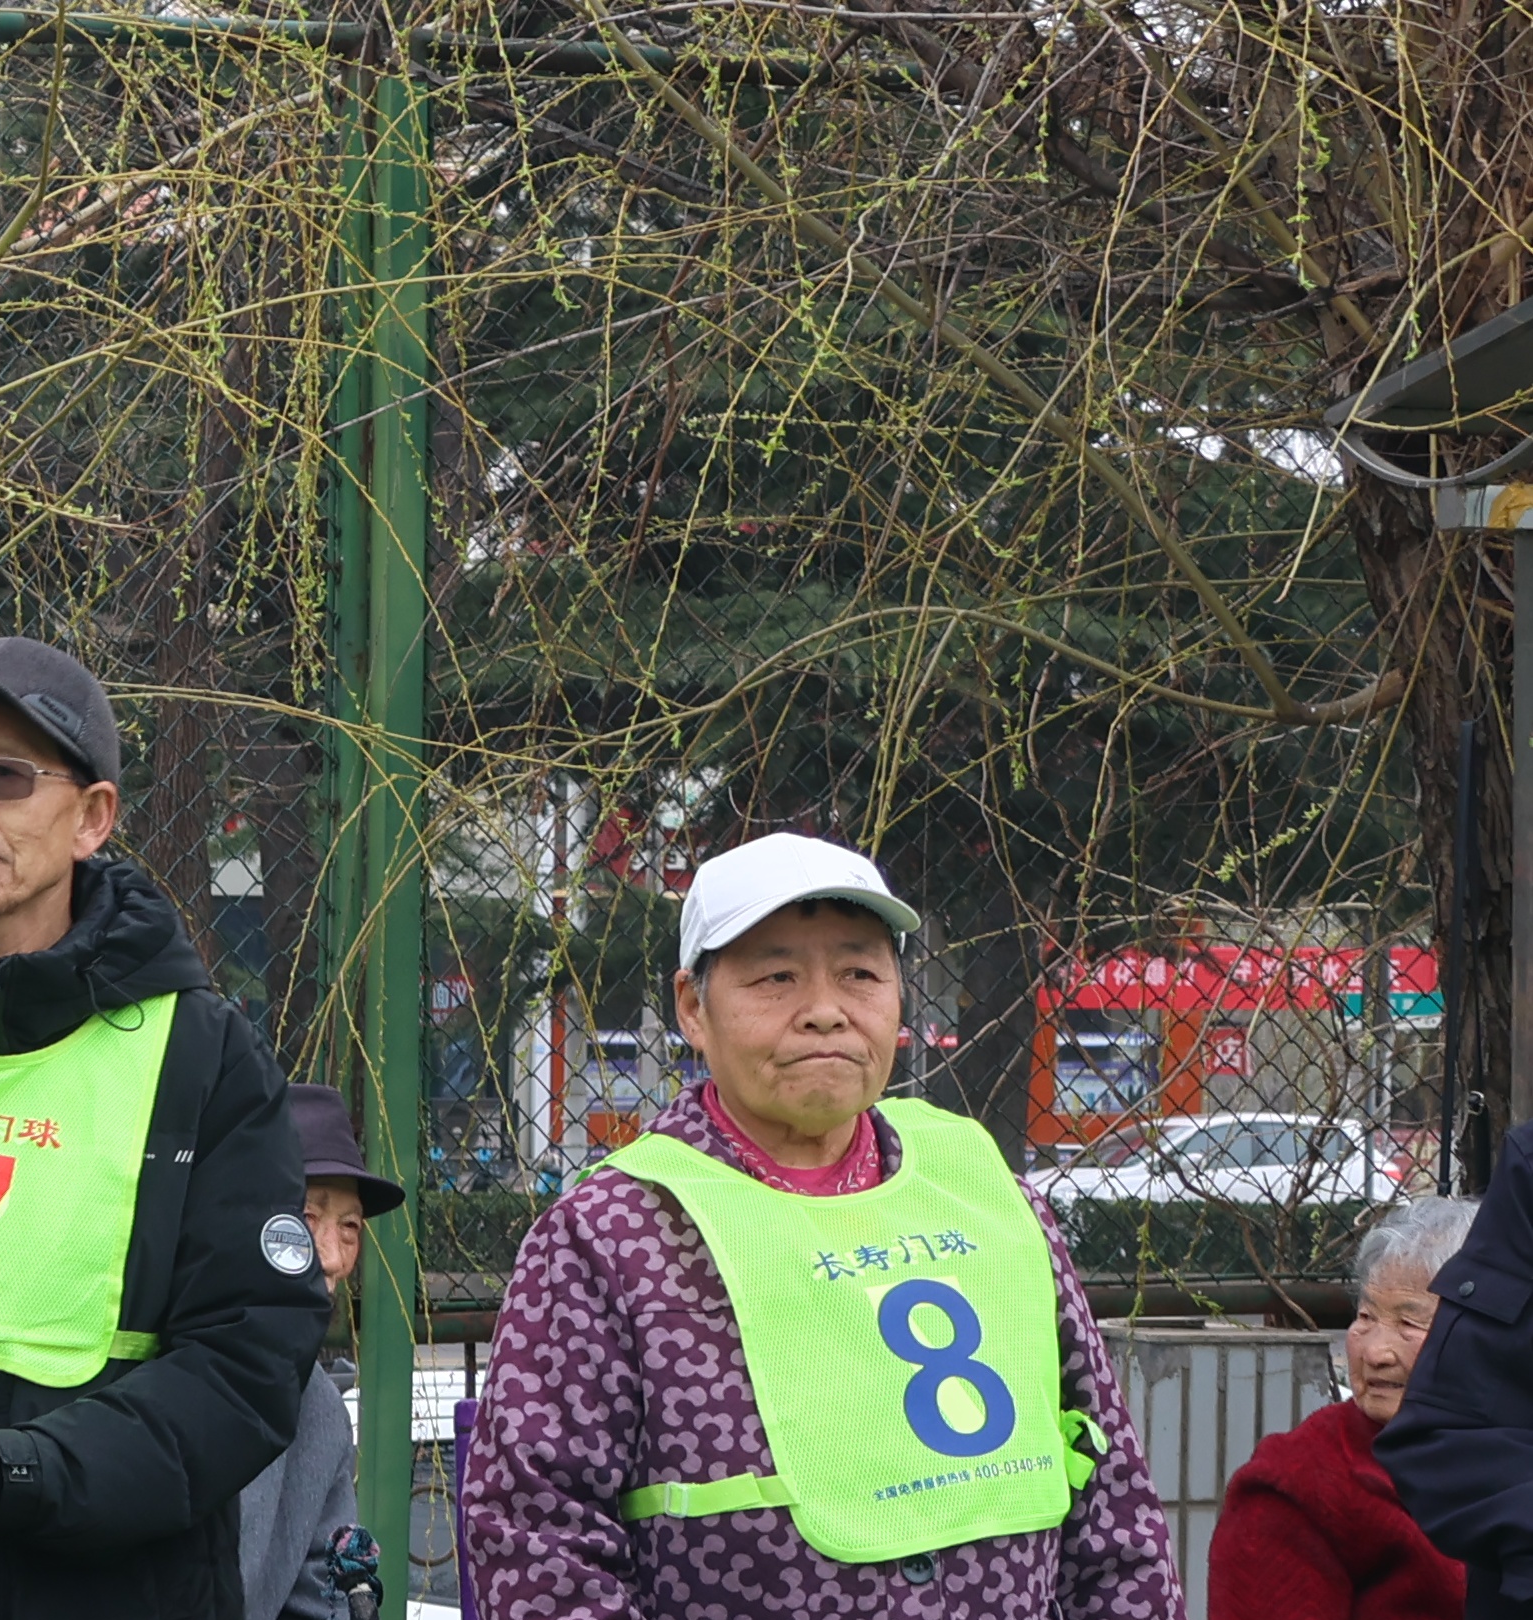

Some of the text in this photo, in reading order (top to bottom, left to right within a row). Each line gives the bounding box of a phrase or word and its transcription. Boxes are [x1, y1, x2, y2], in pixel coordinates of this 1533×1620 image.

[813, 1229, 978, 1281] 长寿门球
[877, 1278, 1017, 1458] 8
